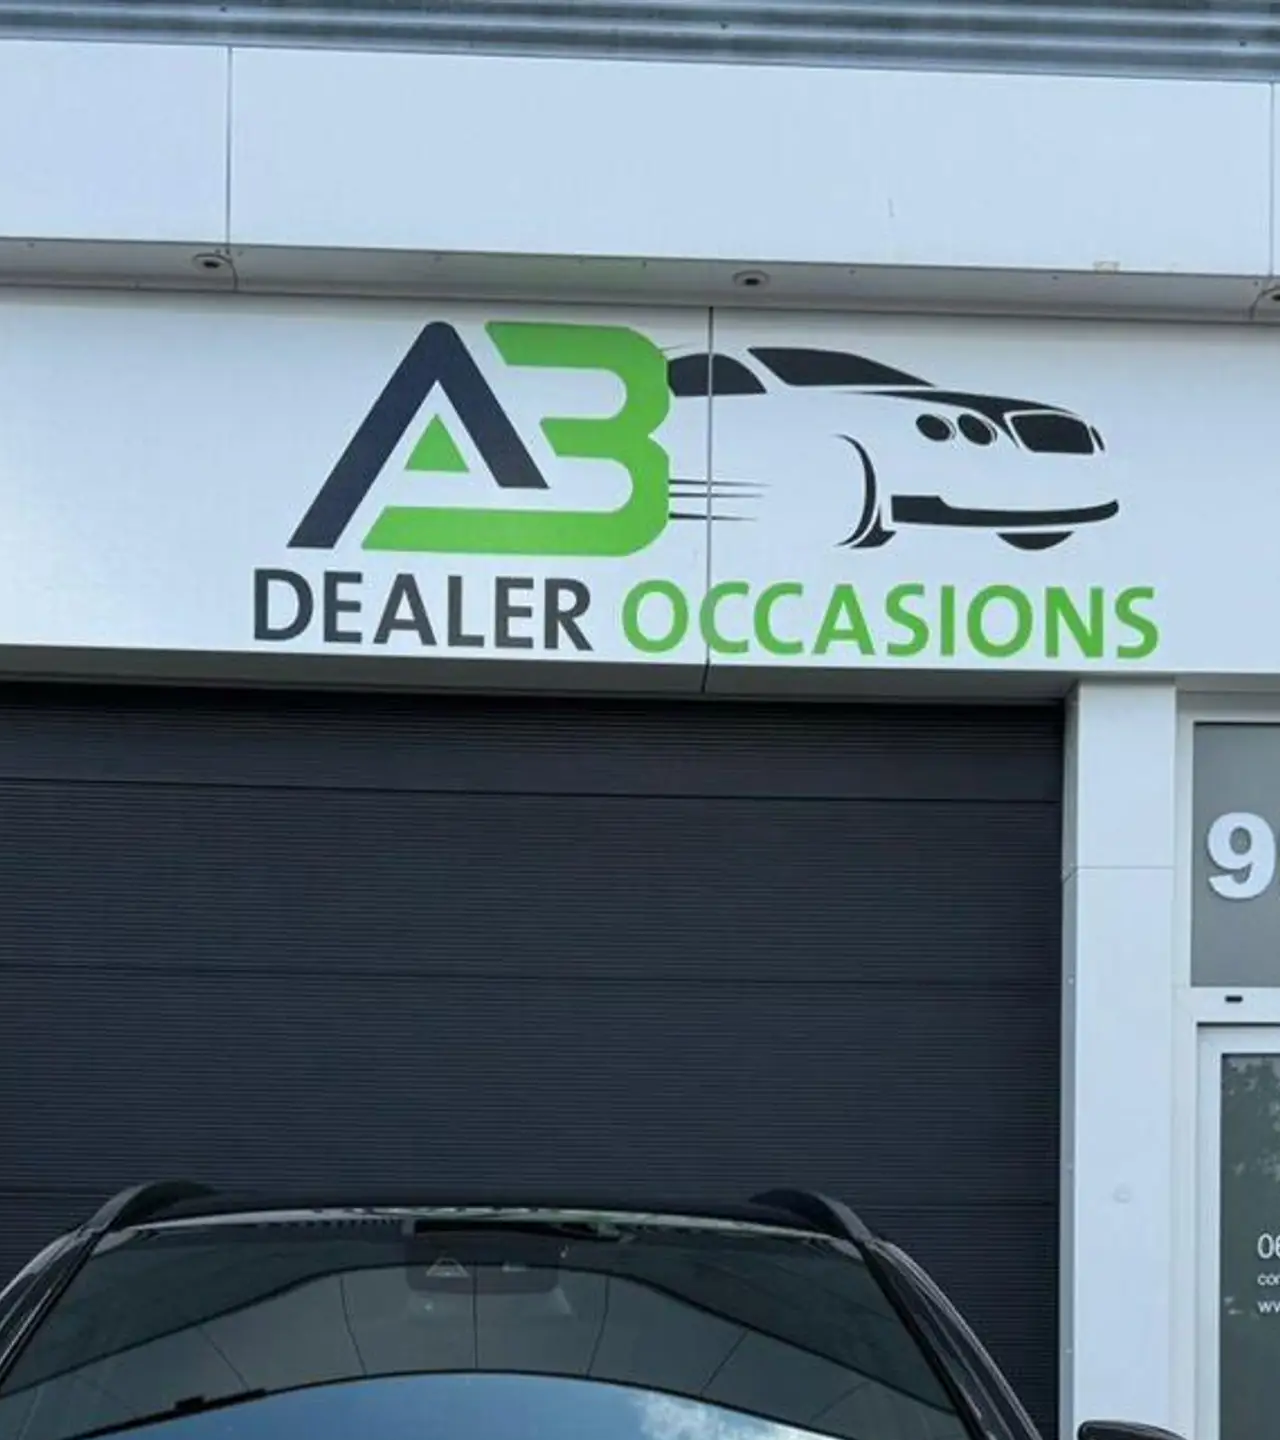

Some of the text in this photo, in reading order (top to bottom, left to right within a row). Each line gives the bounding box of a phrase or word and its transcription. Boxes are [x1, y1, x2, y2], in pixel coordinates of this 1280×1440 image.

[287, 320, 672, 558] AB
[252, 567, 1159, 660] DEALER OCCASIONS
